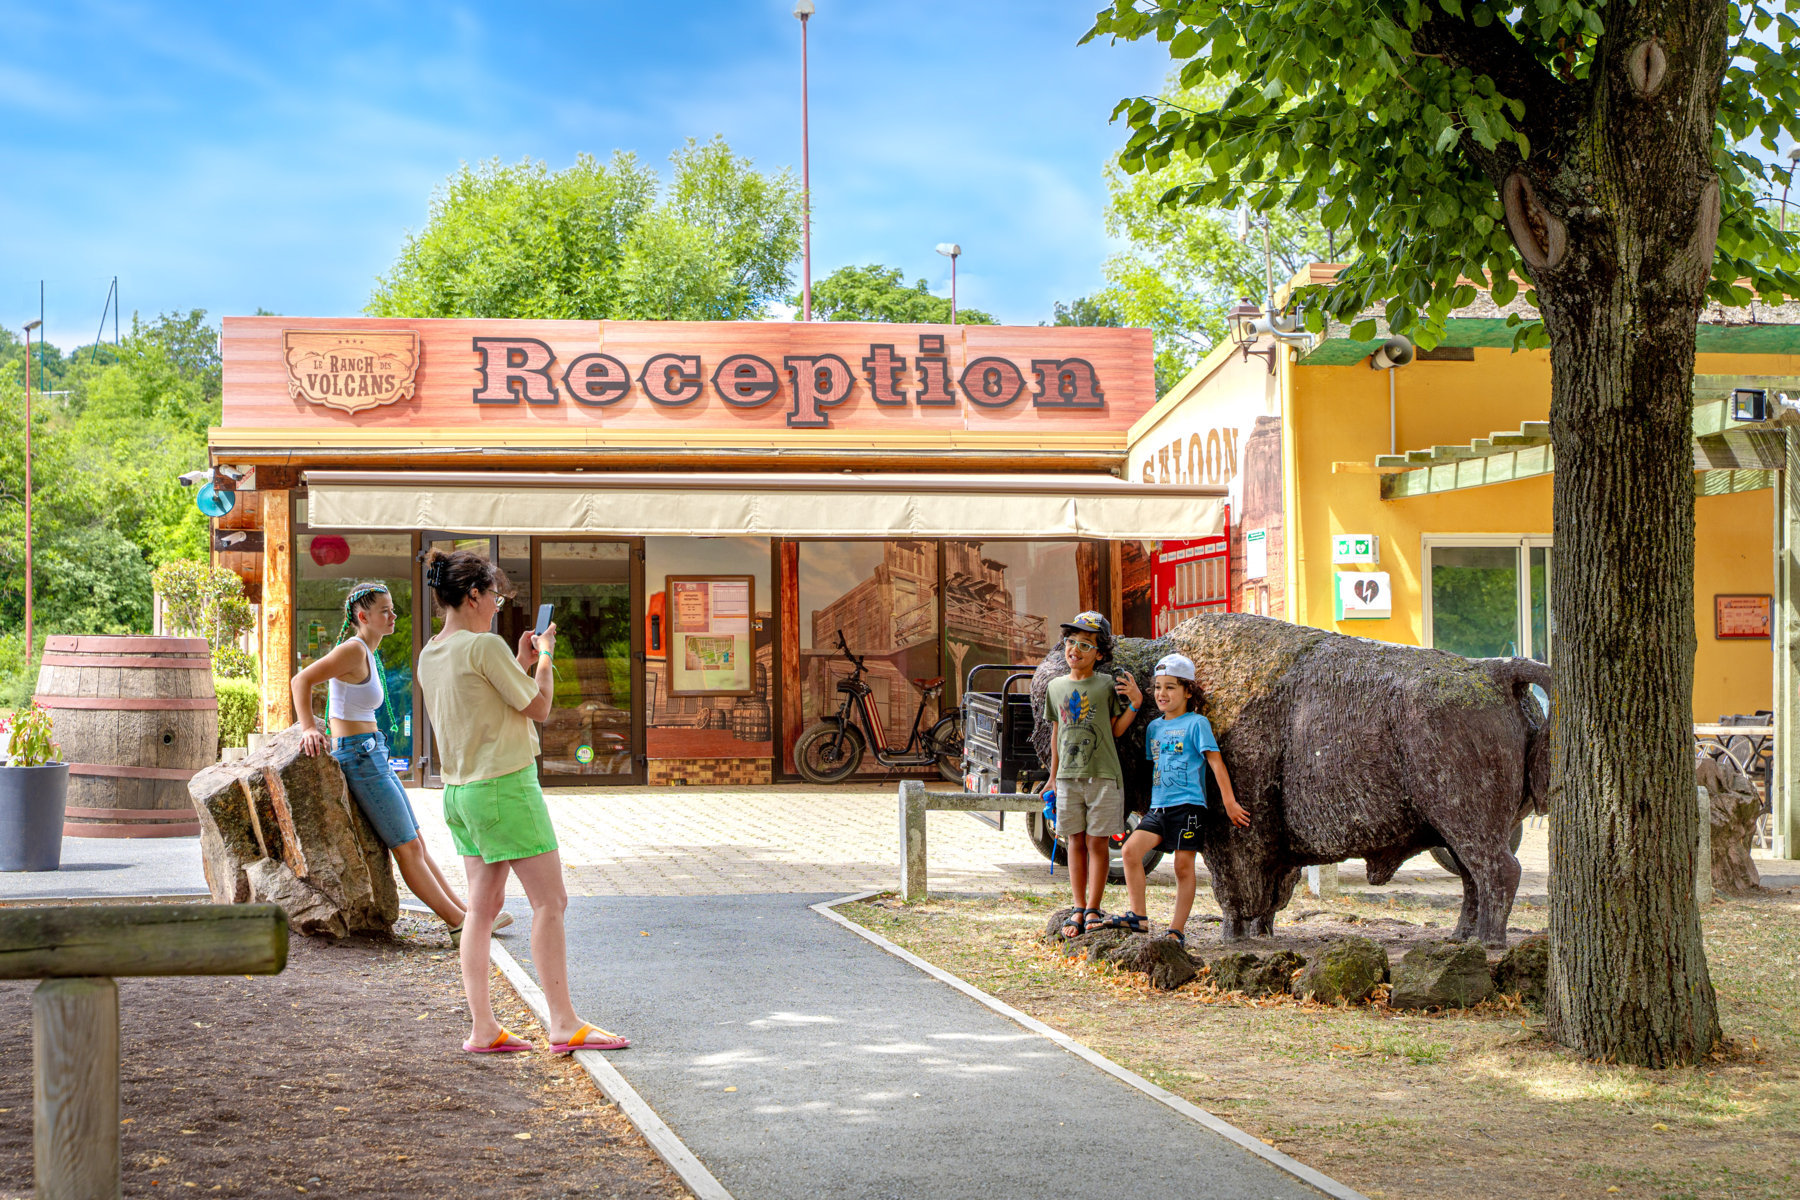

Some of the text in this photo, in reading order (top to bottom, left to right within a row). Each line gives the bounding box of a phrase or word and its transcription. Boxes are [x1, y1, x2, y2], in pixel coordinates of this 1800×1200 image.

[313, 355, 392, 373] LE RANCH DES
[306, 373, 395, 397] VOLCANS
[472, 334, 1104, 428] Reception
